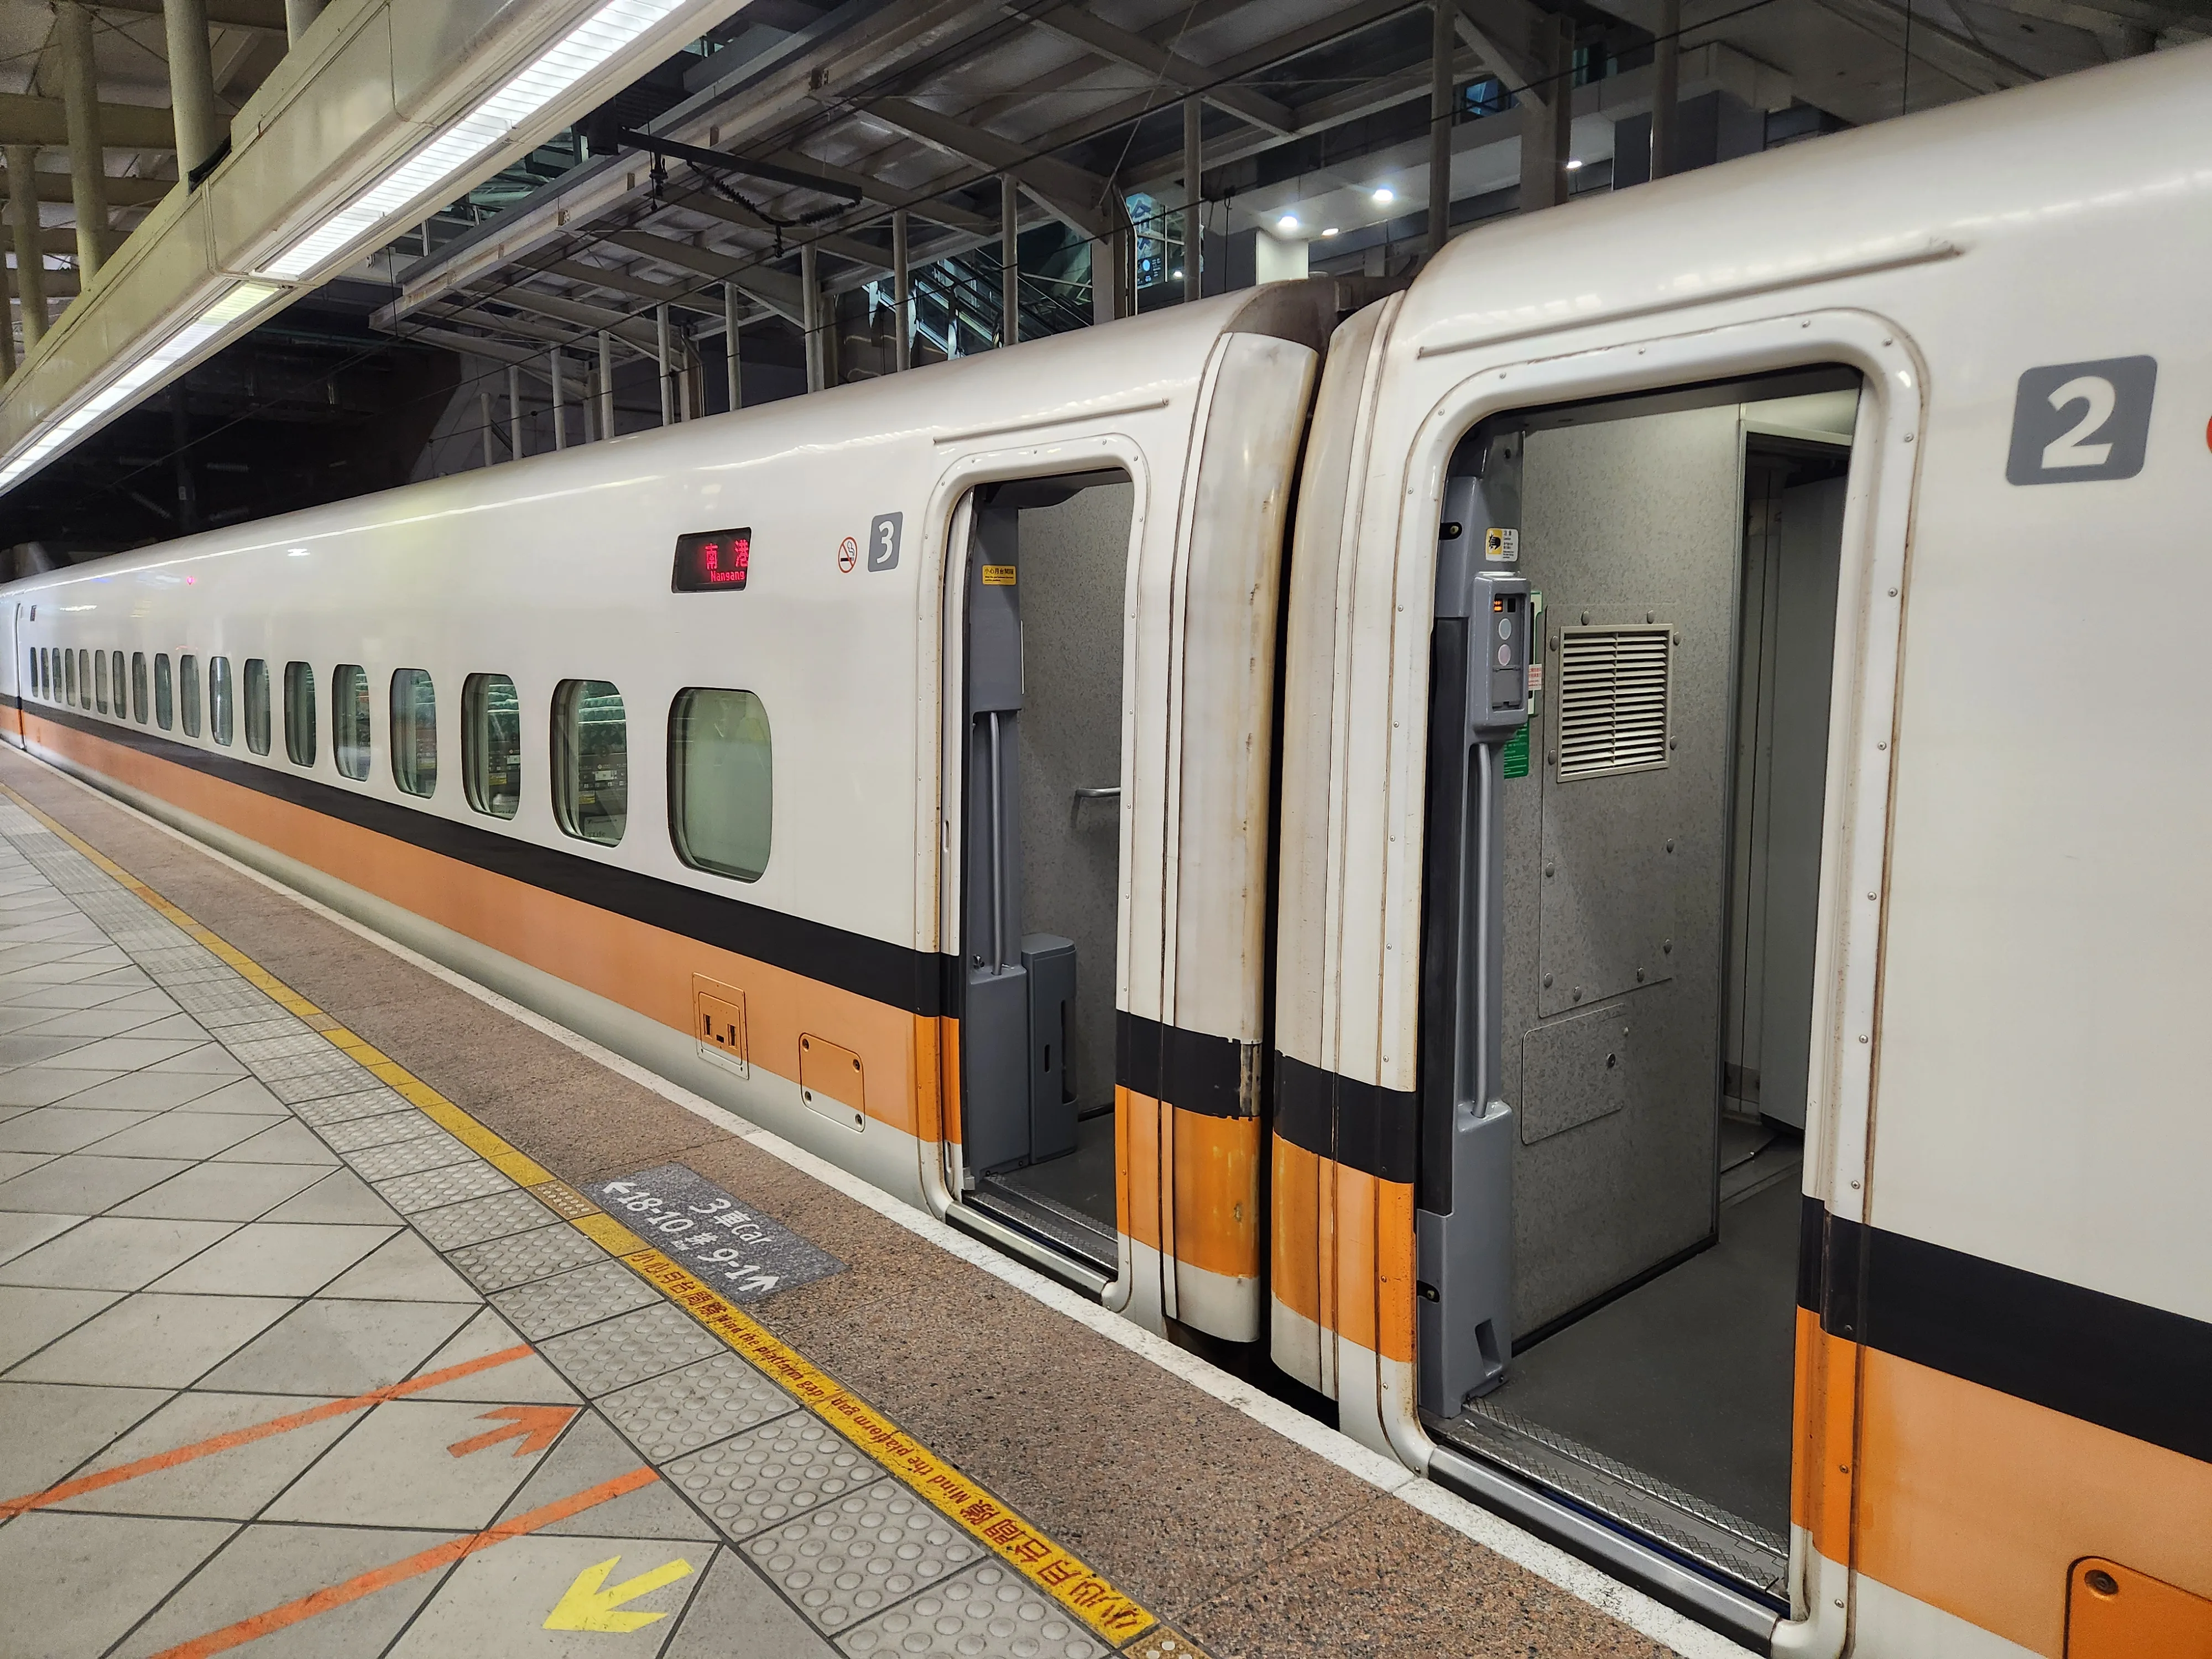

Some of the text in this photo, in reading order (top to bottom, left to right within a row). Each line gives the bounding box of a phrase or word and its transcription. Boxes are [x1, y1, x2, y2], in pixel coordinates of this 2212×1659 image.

[2041, 375, 2116, 469] 2
[705, 539, 748, 570] 南港
[710, 571, 745, 582] Nangang
[877, 520, 894, 564] 3
[617, 1192, 694, 1232] 18-10
[697, 1248, 761, 1280] 9-1
[714, 1314, 744, 1334] Mind
[738, 1333, 760, 1346] the
[752, 1347, 804, 1380] platform
[796, 1380, 824, 1396] gap
[831, 1396, 1138, 1630] 小心月台間隙 Mind the platform gap
